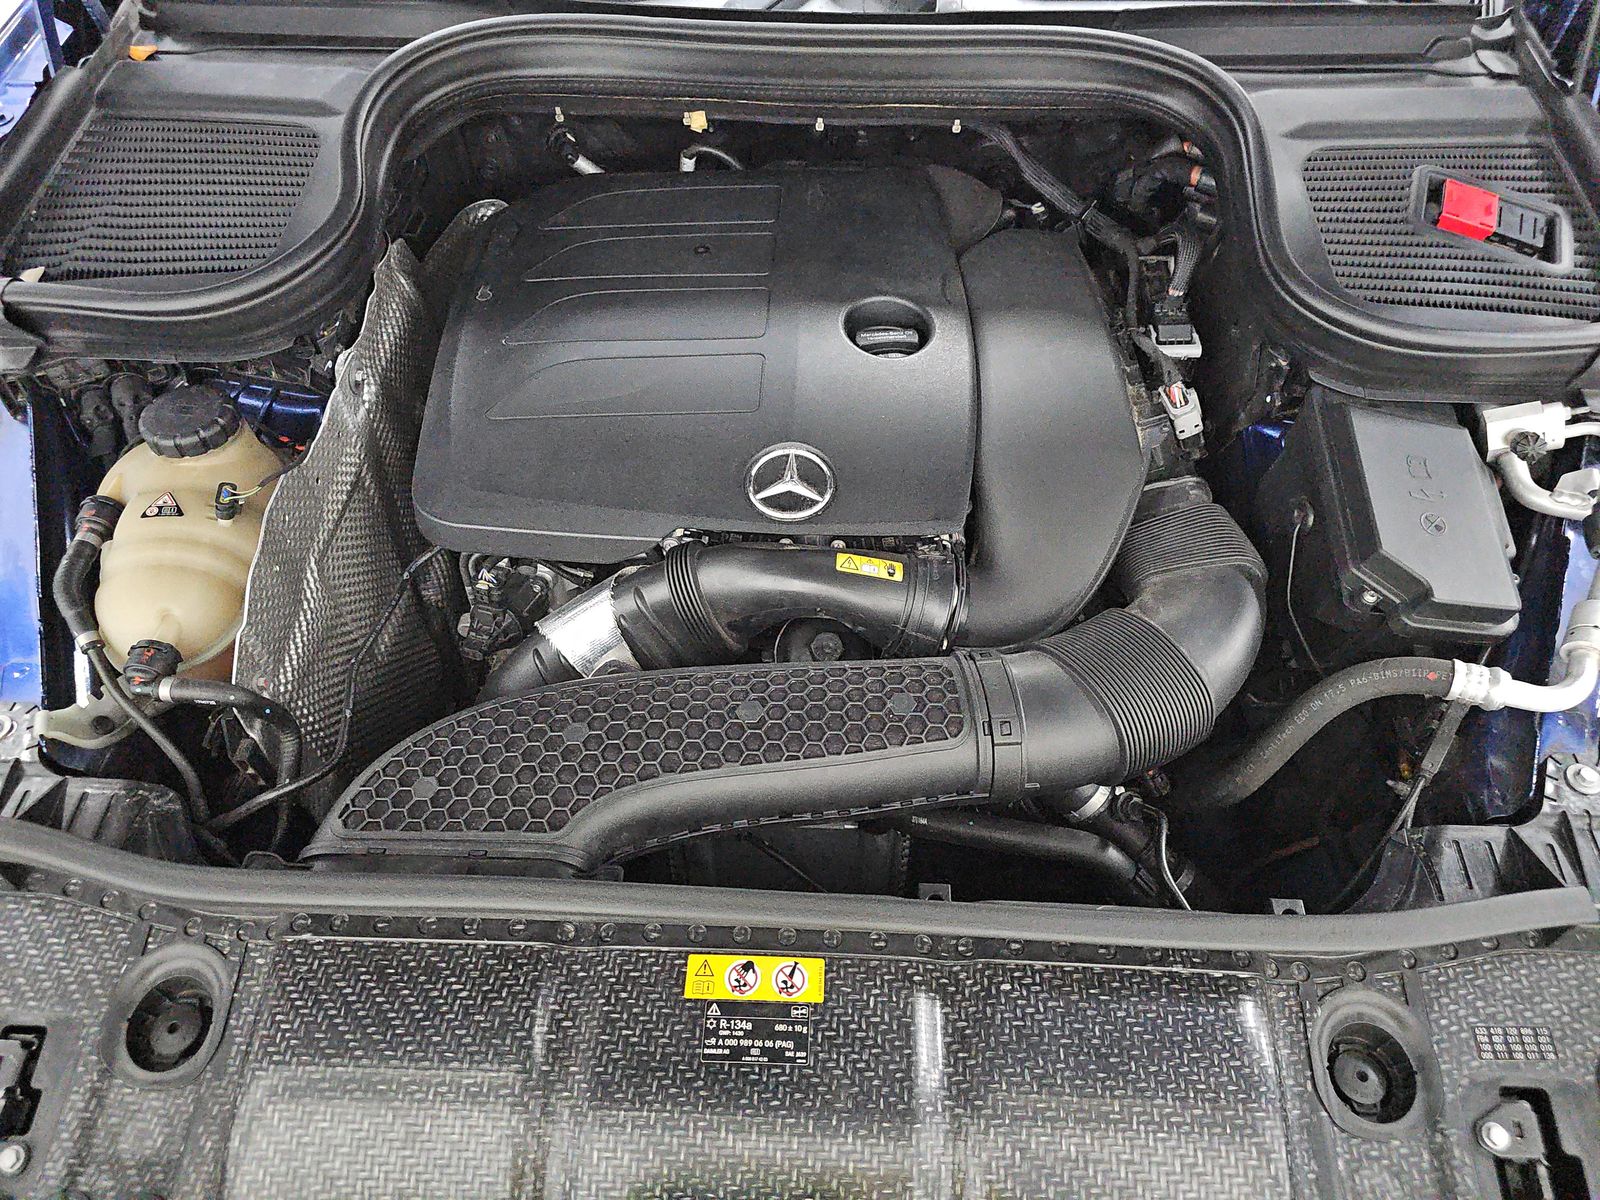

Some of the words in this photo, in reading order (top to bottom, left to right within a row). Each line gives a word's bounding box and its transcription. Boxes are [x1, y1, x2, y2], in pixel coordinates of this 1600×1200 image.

[719, 1019, 752, 1030] R-134a
[1536, 1027, 1548, 1035] 115
[1506, 1035, 1519, 1043] 011
[1522, 1035, 1534, 1043] 001
[1537, 1035, 1550, 1043] 001
[717, 1038, 724, 1046] A
[724, 1038, 739, 1047] 000
[739, 1039, 753, 1047] 989
[753, 1039, 764, 1048] 06
[764, 1040, 774, 1048] 06
[775, 1040, 794, 1050] (PAG)
[1480, 1043, 1492, 1051] 100
[1494, 1043, 1506, 1051] 001
[1510, 1043, 1522, 1051] 100
[1524, 1043, 1537, 1051] 010
[1540, 1043, 1553, 1051] 010
[1481, 1051, 1494, 1059] 000
[1497, 1051, 1508, 1059] 111
[1512, 1051, 1524, 1059] 100
[1526, 1051, 1539, 1059] 011
